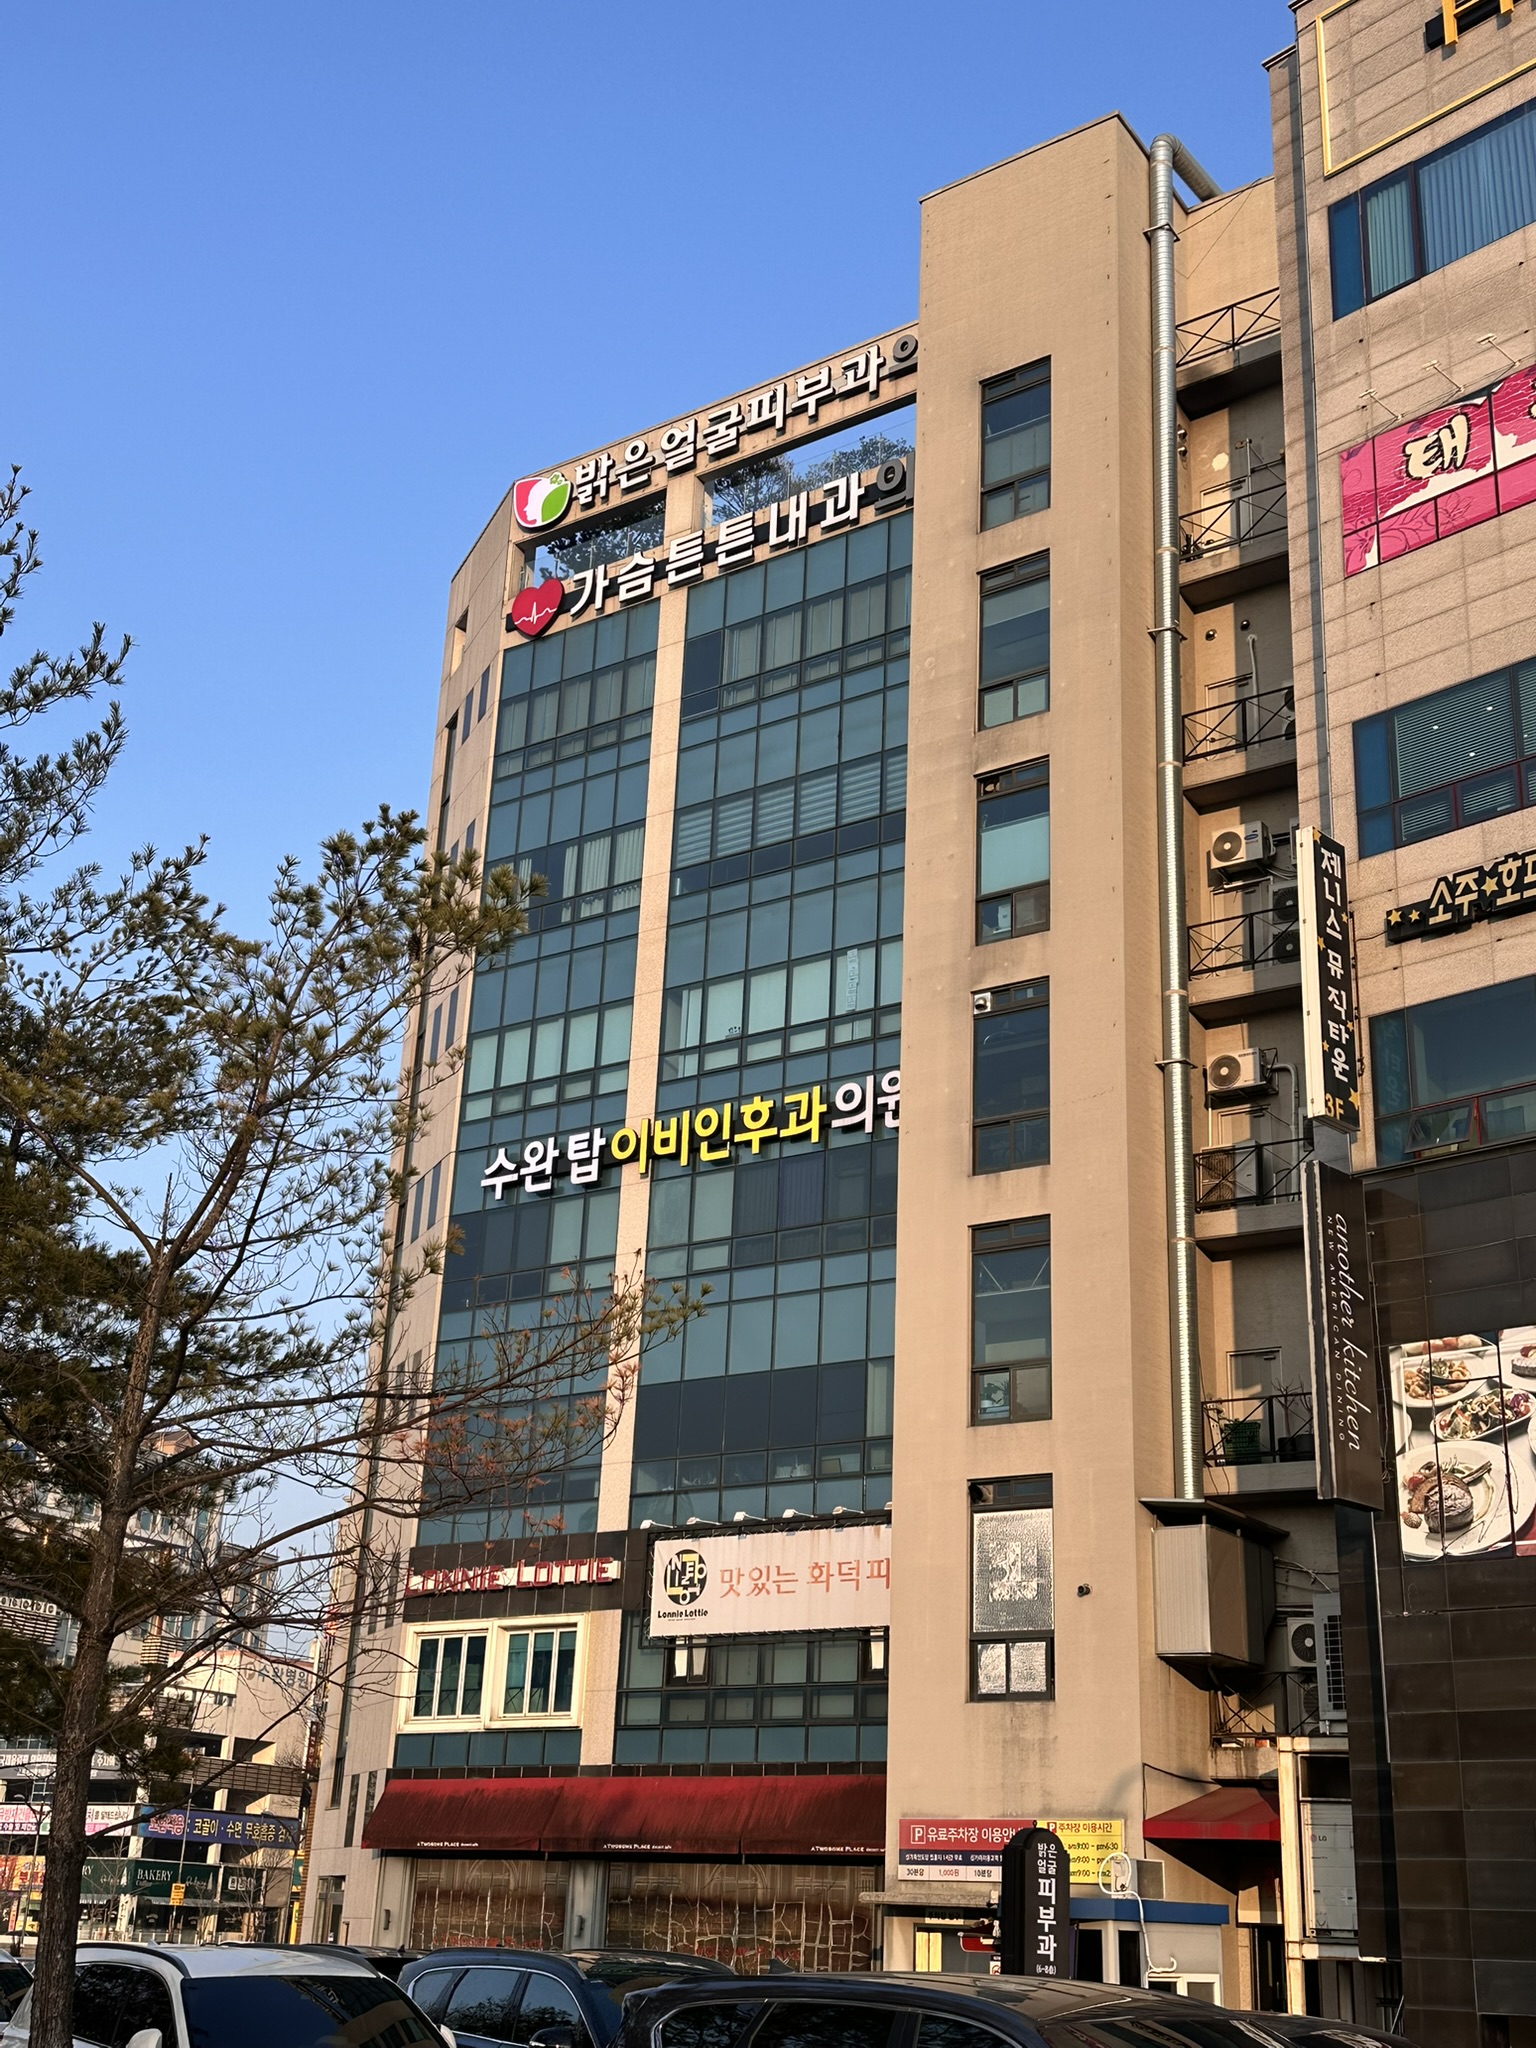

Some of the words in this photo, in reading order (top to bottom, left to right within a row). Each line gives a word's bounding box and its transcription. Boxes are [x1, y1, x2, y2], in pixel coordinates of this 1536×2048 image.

[1325, 1093, 1345, 1121] 3F
[1327, 1215, 1335, 1251] NEW
[1335, 1213, 1365, 1329] another
[1329, 1263, 1341, 1359] AMERICAN
[1342, 1337, 1372, 1450] kitchen
[404, 1564, 505, 1600] LONNIE
[516, 1556, 615, 1590] LOTTIE
[719, 1565, 799, 1599] 맛있는
[657, 1610, 684, 1618] Lonnie
[684, 1608, 709, 1618] Lottie
[192, 1818, 219, 1838] 코골이
[927, 1826, 979, 1843] 유료주차장
[981, 1826, 1024, 1844] 이용안
[1059, 1822, 1081, 1833] 주차장
[1083, 1822, 1113, 1833] 이용시간
[1037, 1842, 1058, 1859] 밝은
[137, 1868, 173, 1882] BAKERY
[1037, 1859, 1058, 1875] 얼굴
[1036, 1878, 1058, 1962] 피부과
